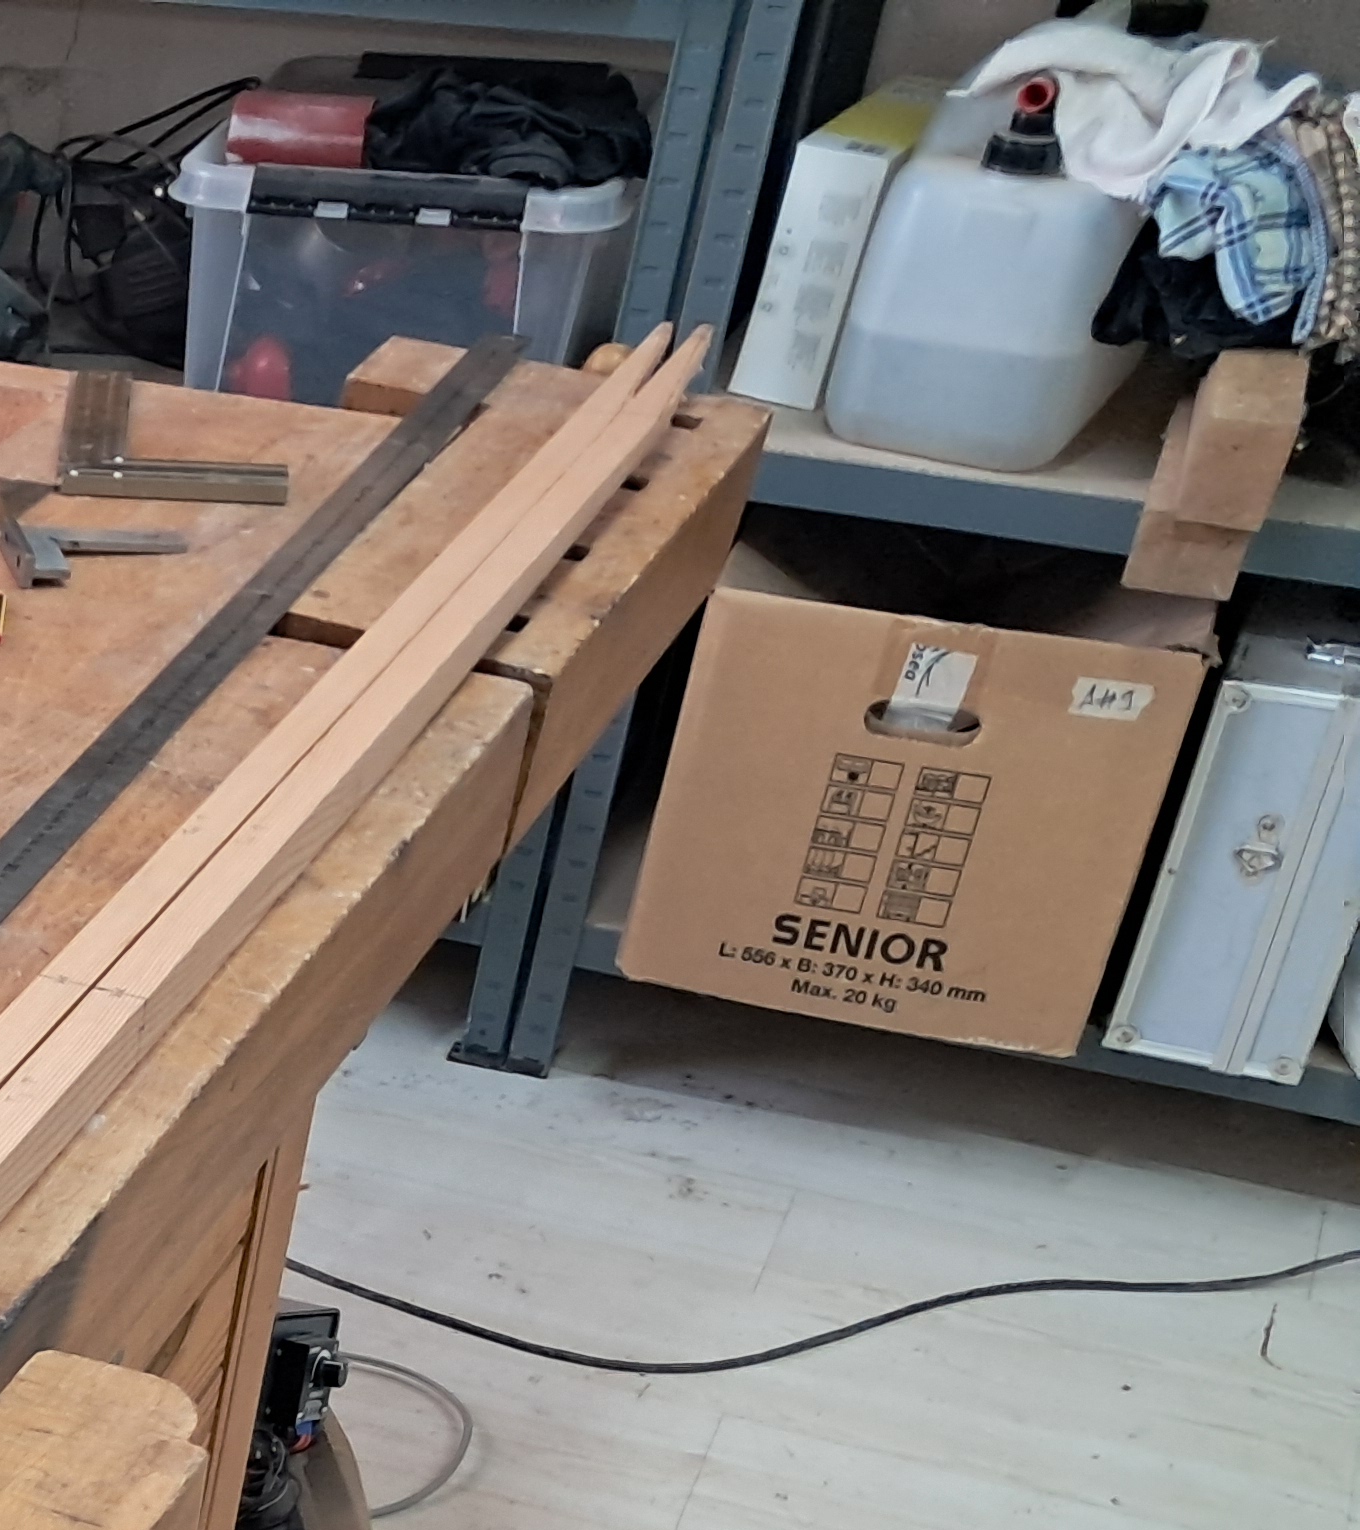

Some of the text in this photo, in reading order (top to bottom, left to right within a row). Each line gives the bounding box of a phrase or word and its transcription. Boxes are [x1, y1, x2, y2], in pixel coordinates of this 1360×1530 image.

[719, 941, 736, 959] L:
[780, 957, 792, 970] x
[796, 957, 817, 974] B:
[822, 962, 858, 982] 370
[862, 972, 875, 984] x
[879, 972, 902, 989] H:
[905, 976, 943, 996] 340
[946, 985, 987, 1002] mm
[772, 914, 948, 973] SENIOR
[791, 978, 897, 1014] Max. 20 kg
